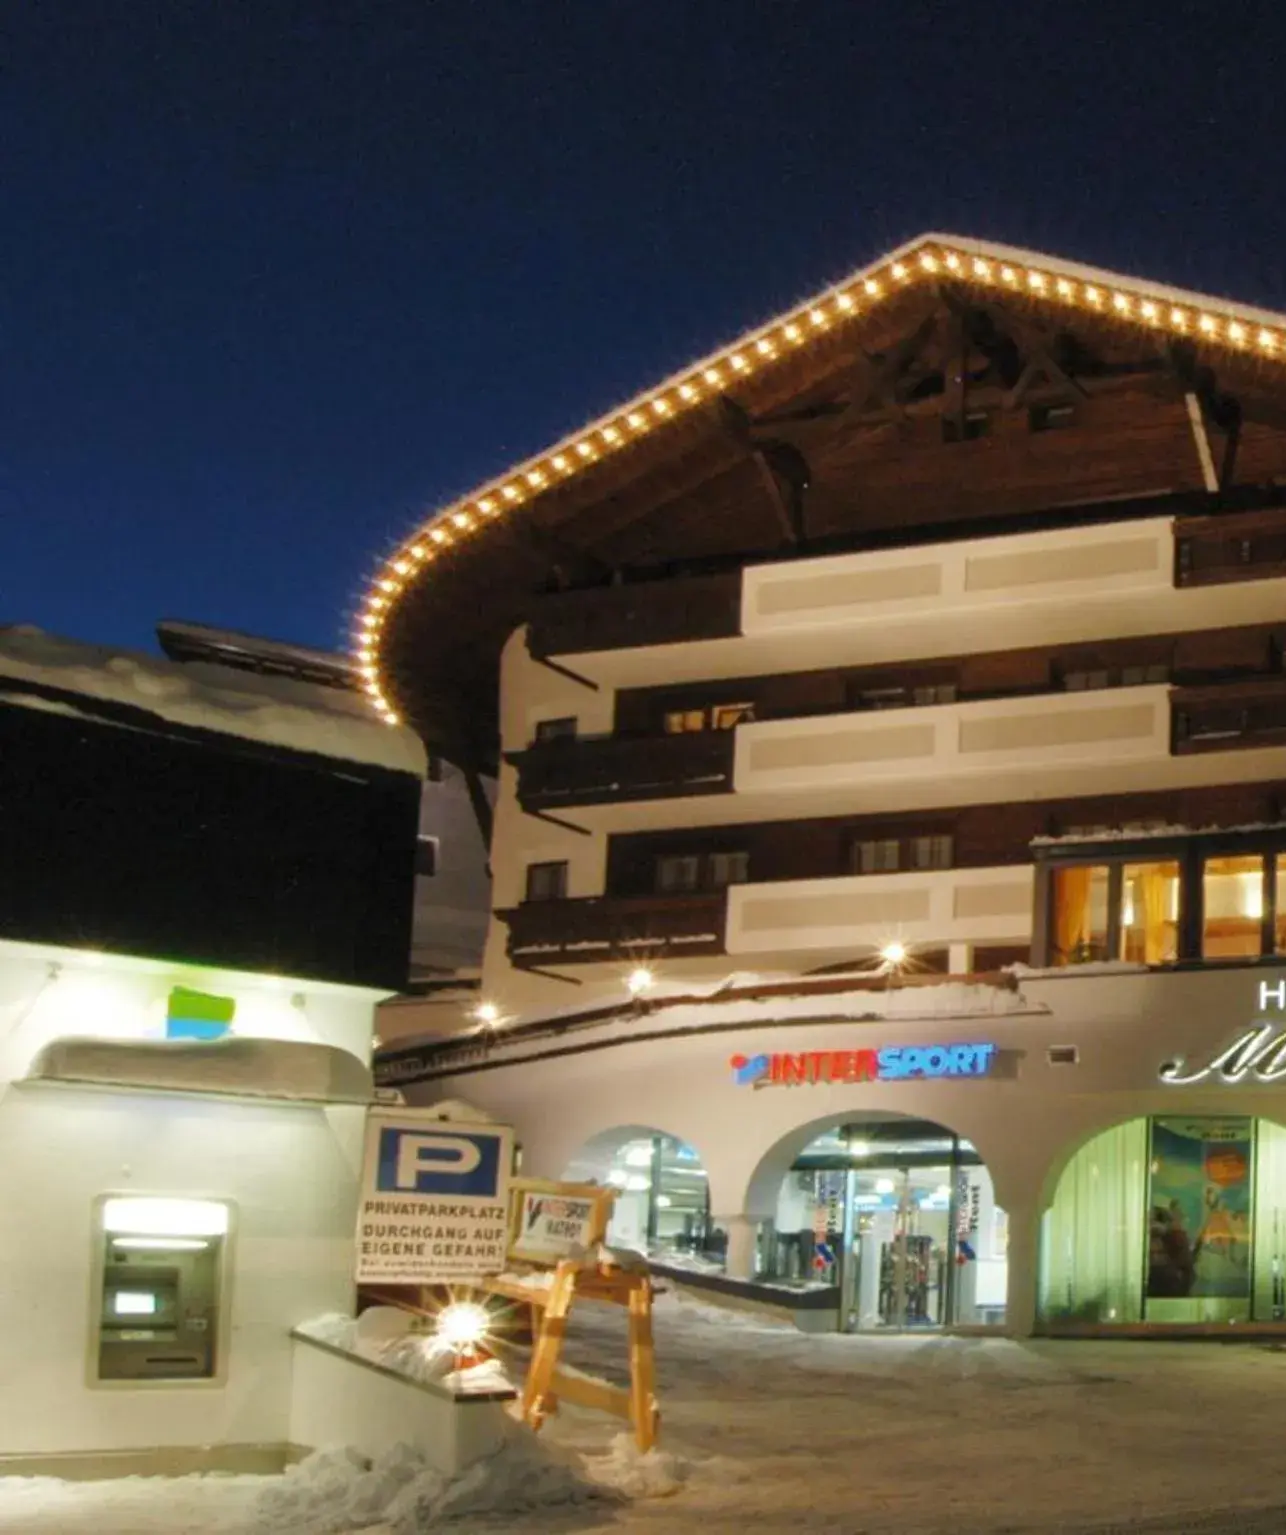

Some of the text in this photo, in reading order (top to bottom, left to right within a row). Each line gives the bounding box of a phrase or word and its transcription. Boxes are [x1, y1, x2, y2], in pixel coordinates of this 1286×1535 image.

[770, 1044, 995, 1082] INTERSPORT
[397, 1134, 482, 1189] P
[364, 1201, 505, 1220] PRIVATPARKPLATZ
[363, 1224, 504, 1241] DURCHGANG AUF
[362, 1242, 425, 1256] EIGENE
